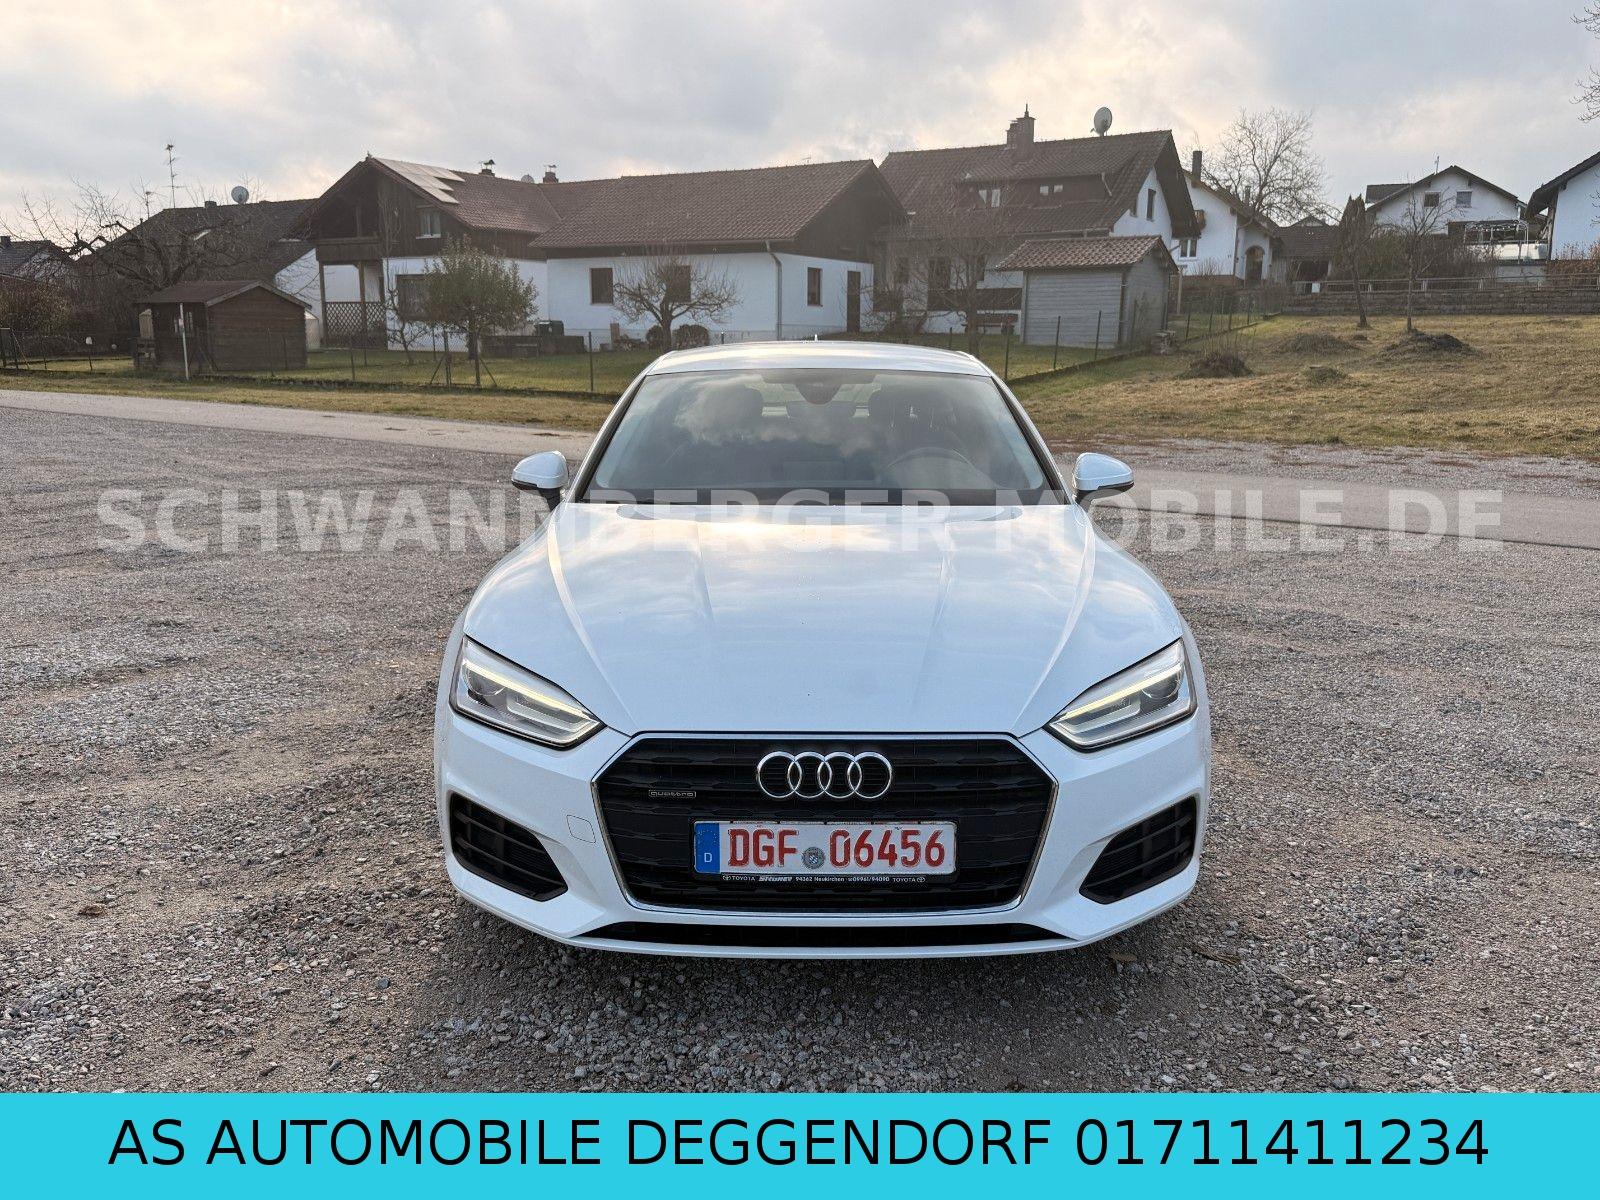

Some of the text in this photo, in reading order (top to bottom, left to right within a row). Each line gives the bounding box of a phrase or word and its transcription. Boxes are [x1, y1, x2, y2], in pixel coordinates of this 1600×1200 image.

[703, 852, 713, 863] D
[728, 829, 946, 868] DGF 06456
